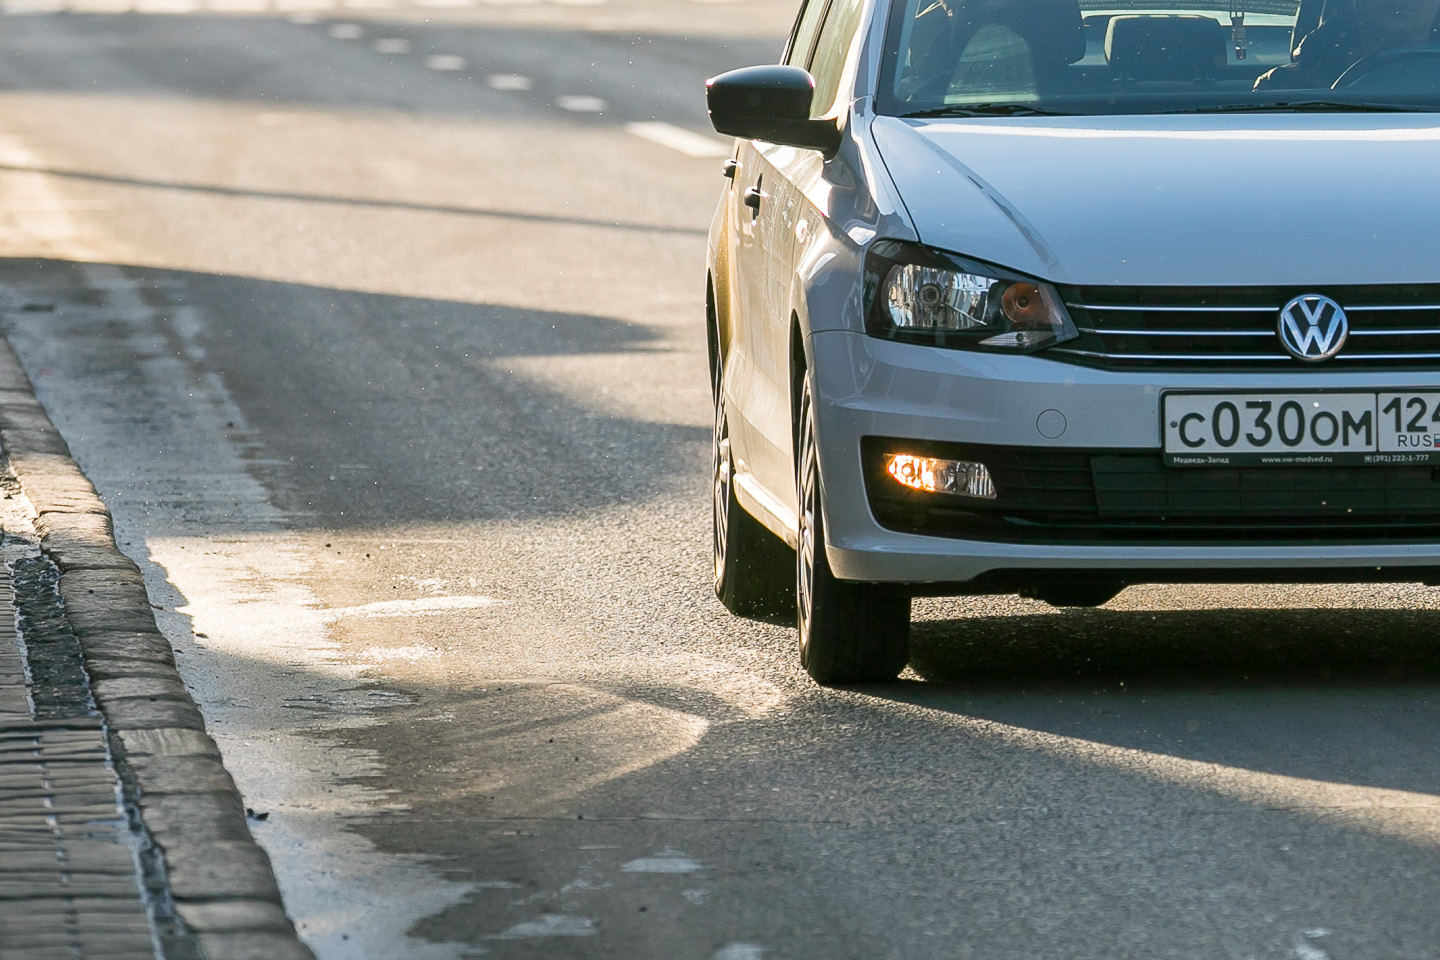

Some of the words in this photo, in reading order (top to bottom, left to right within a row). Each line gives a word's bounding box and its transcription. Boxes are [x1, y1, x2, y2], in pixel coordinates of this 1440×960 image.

[1178, 400, 1372, 447] С030ОМ
[1397, 433, 1432, 447] RUS
[1173, 456, 1230, 464] Медведь-Запад
[1261, 455, 1333, 463] www.vw-medved.ru
